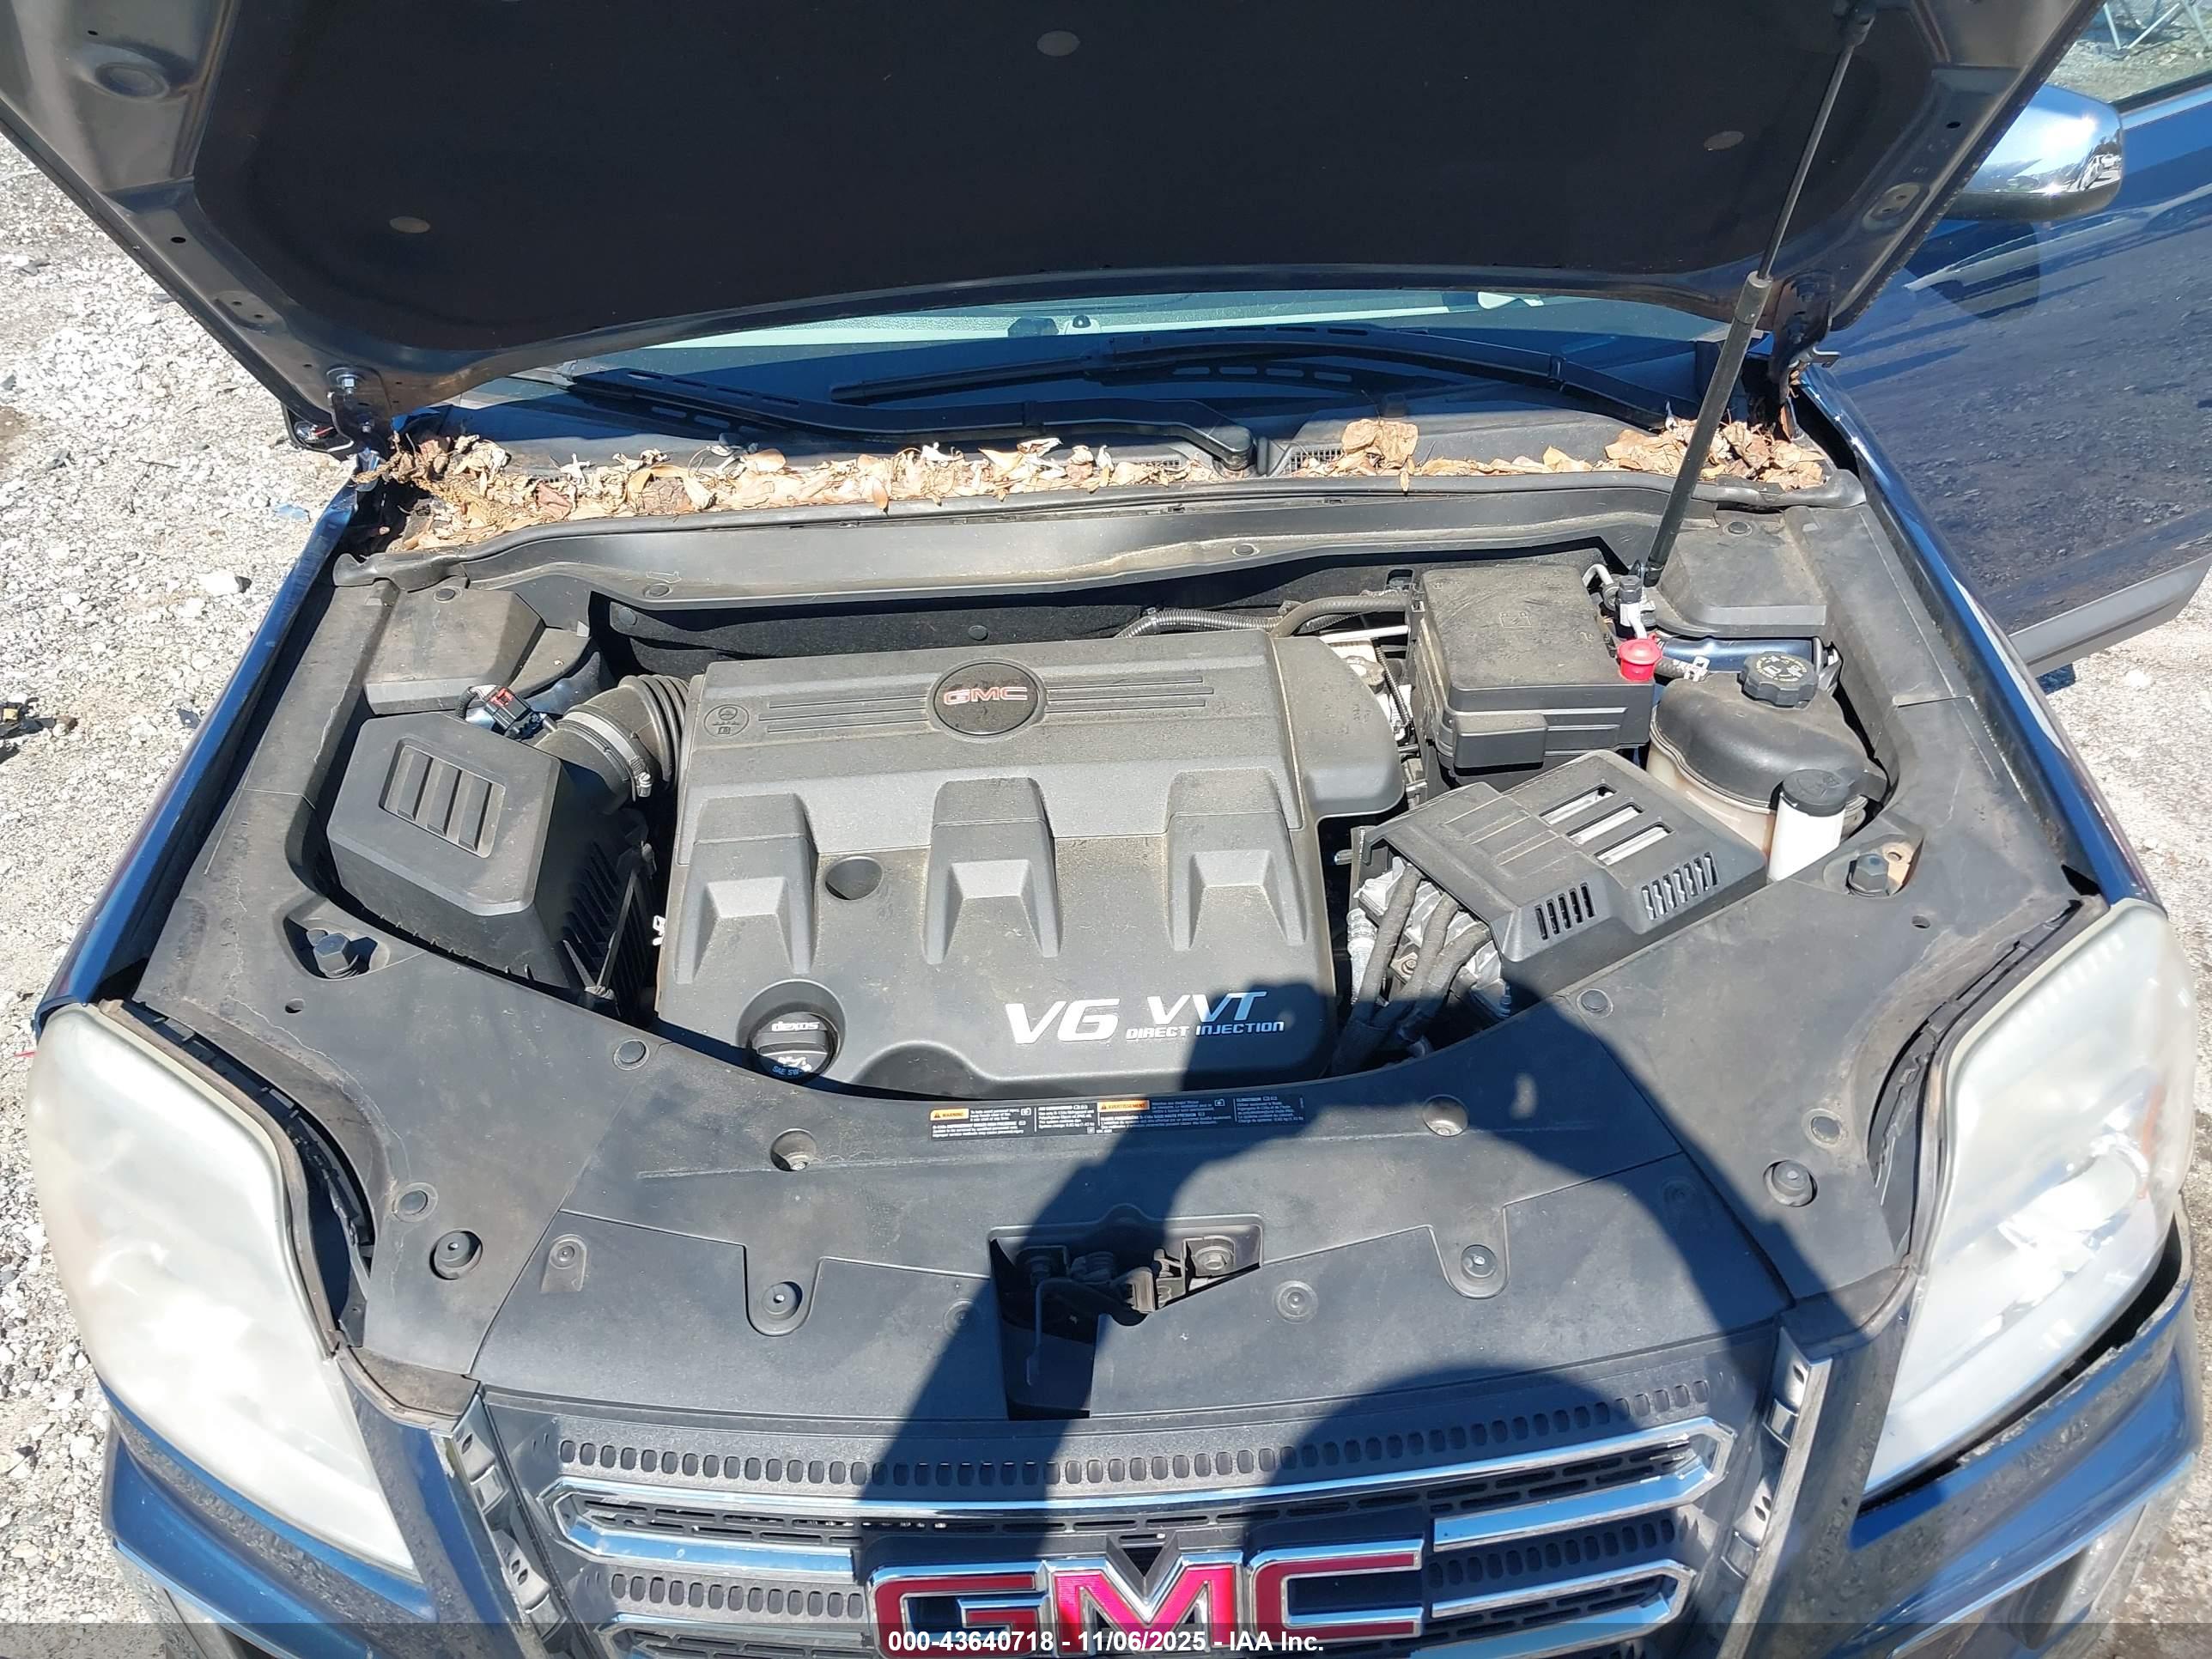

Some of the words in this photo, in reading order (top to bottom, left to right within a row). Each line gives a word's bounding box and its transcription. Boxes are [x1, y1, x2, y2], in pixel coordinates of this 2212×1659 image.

[944, 686, 1029, 706] GMC
[1005, 998, 1121, 1045] V6
[1146, 991, 1267, 1025] VVT
[1126, 1025, 1190, 1041] DIRECT
[1195, 1021, 1285, 1036] INJECTION
[866, 1539, 1425, 1659] GMC
